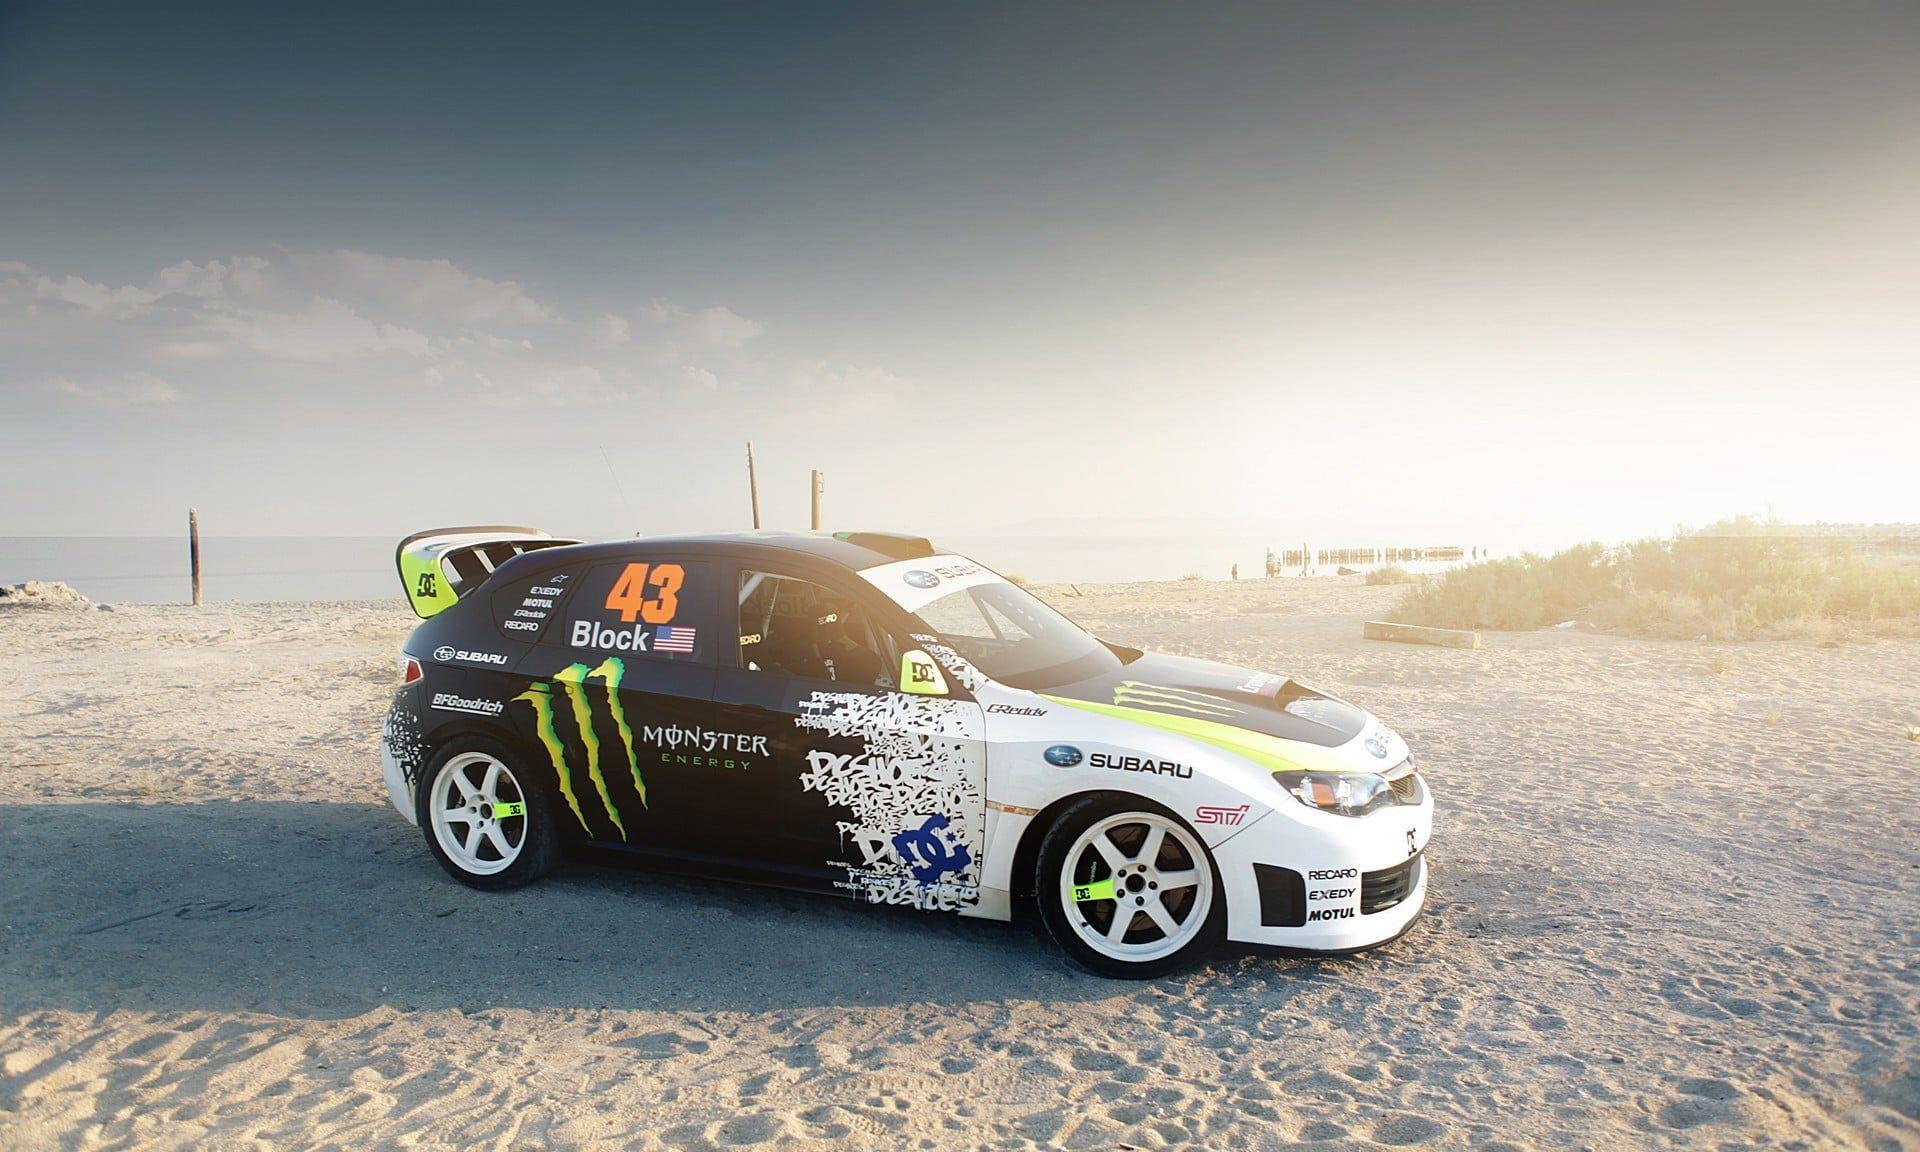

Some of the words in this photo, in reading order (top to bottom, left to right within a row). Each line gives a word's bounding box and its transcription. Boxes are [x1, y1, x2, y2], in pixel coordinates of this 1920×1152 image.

[530, 586, 563, 596] EXEDY
[605, 563, 686, 624] 43
[522, 598, 553, 608] MOTUL
[504, 620, 539, 632] RECARO
[570, 620, 650, 651] Block
[455, 650, 508, 665] SUBARU
[432, 693, 504, 713] BFGoodrich
[986, 704, 1048, 717] GReddy
[643, 724, 770, 757] MONSTER
[661, 753, 751, 770] ENERGY
[1089, 753, 1193, 779] SUBARU
[1308, 868, 1358, 881] RECARO
[1308, 888, 1357, 901] EXEDY
[1308, 908, 1355, 922] MOTUL
